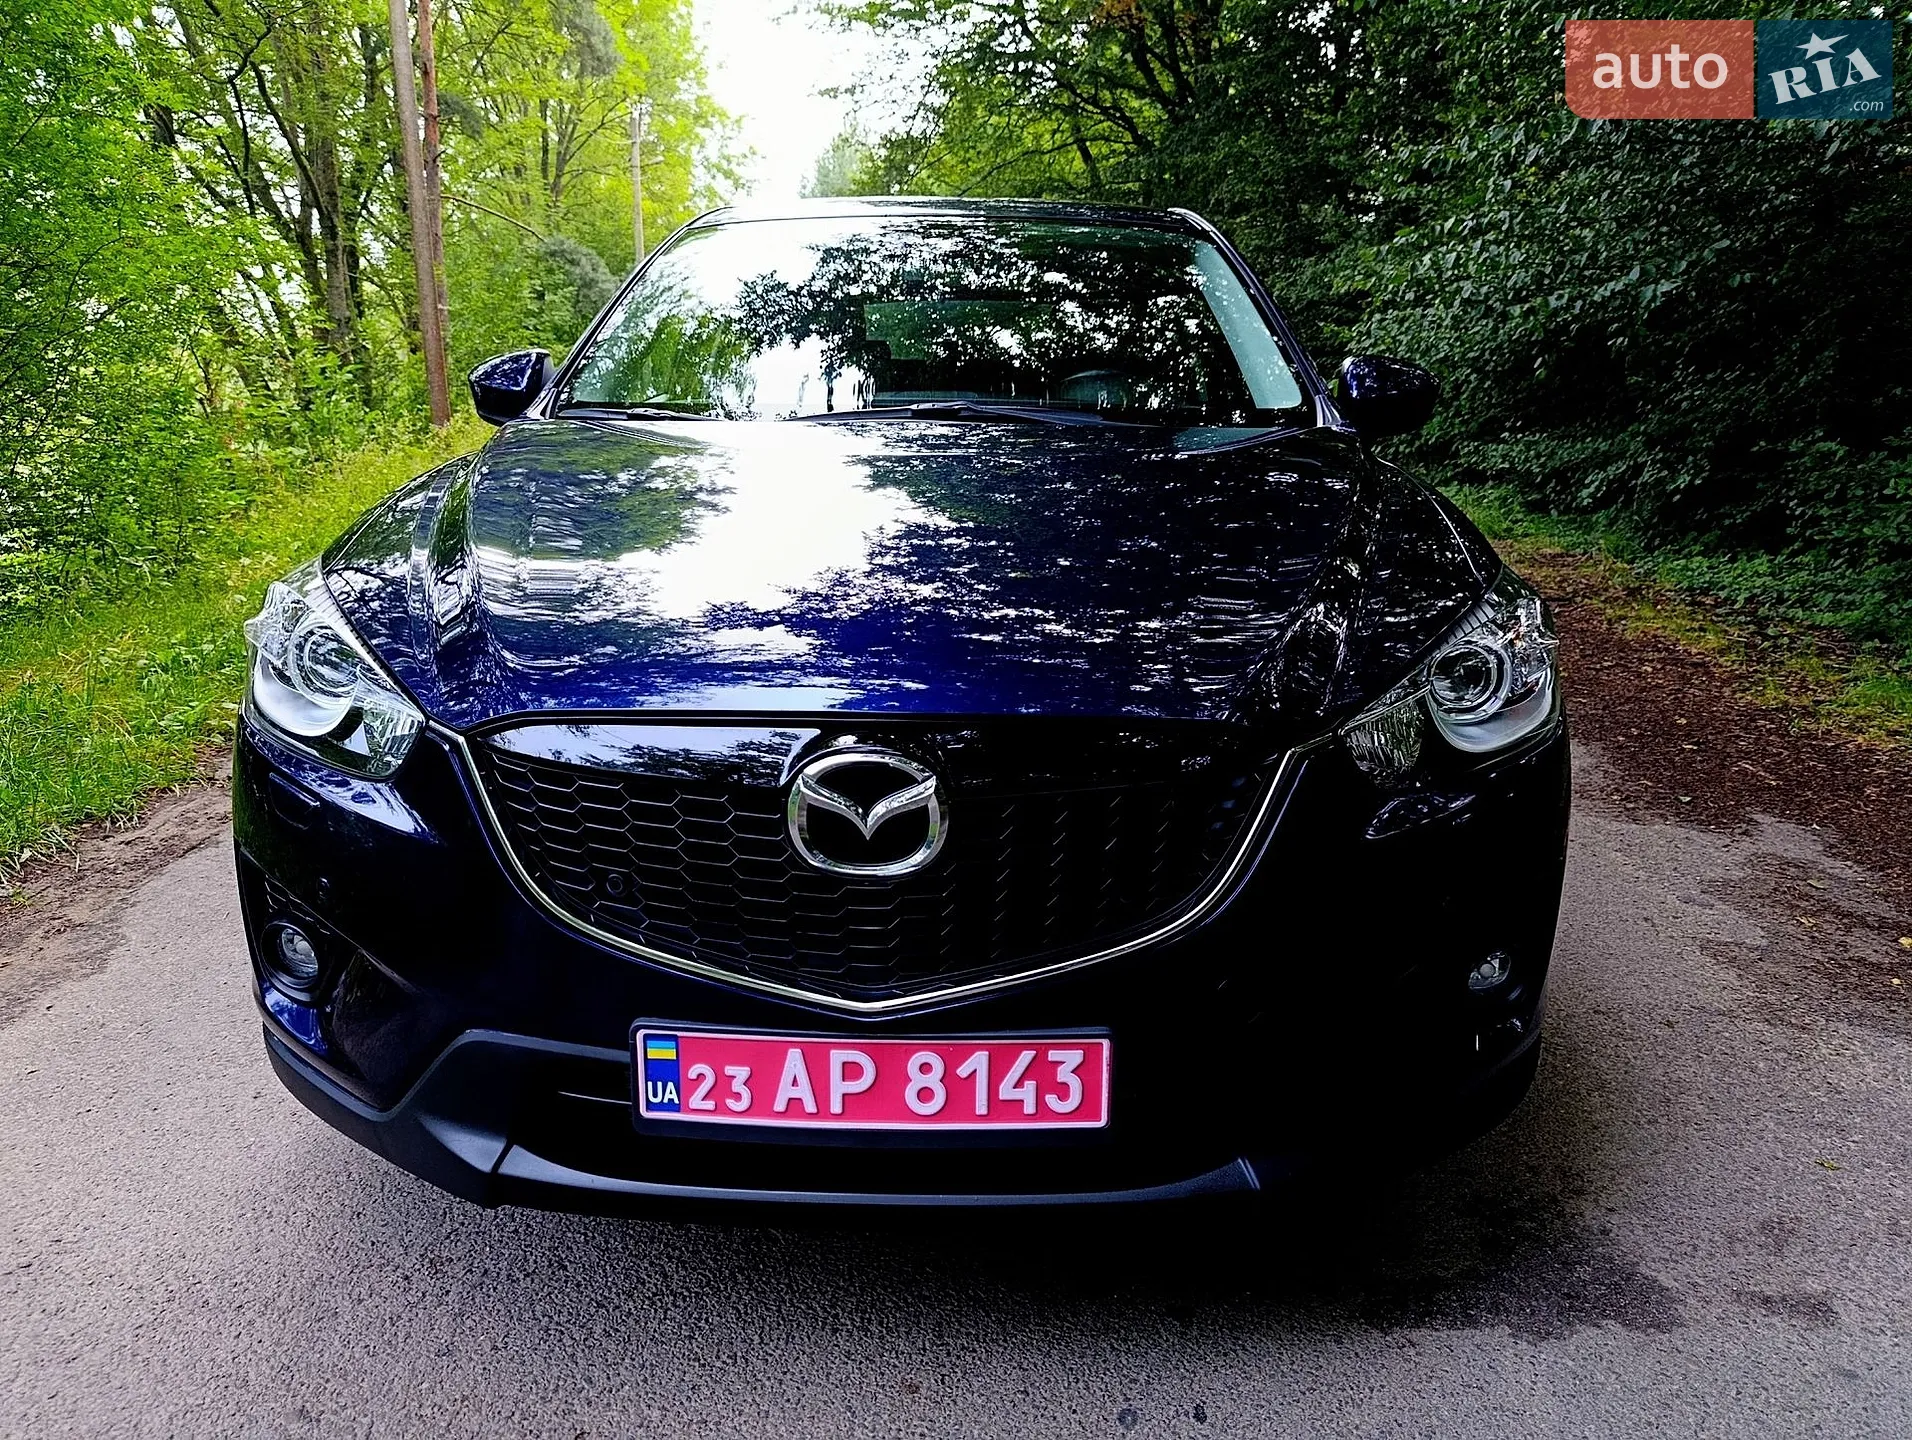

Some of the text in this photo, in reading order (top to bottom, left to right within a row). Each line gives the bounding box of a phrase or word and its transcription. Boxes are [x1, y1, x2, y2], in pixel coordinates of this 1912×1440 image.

[647, 1080, 679, 1105] UA
[687, 1048, 1084, 1116] 23 AP 8143
